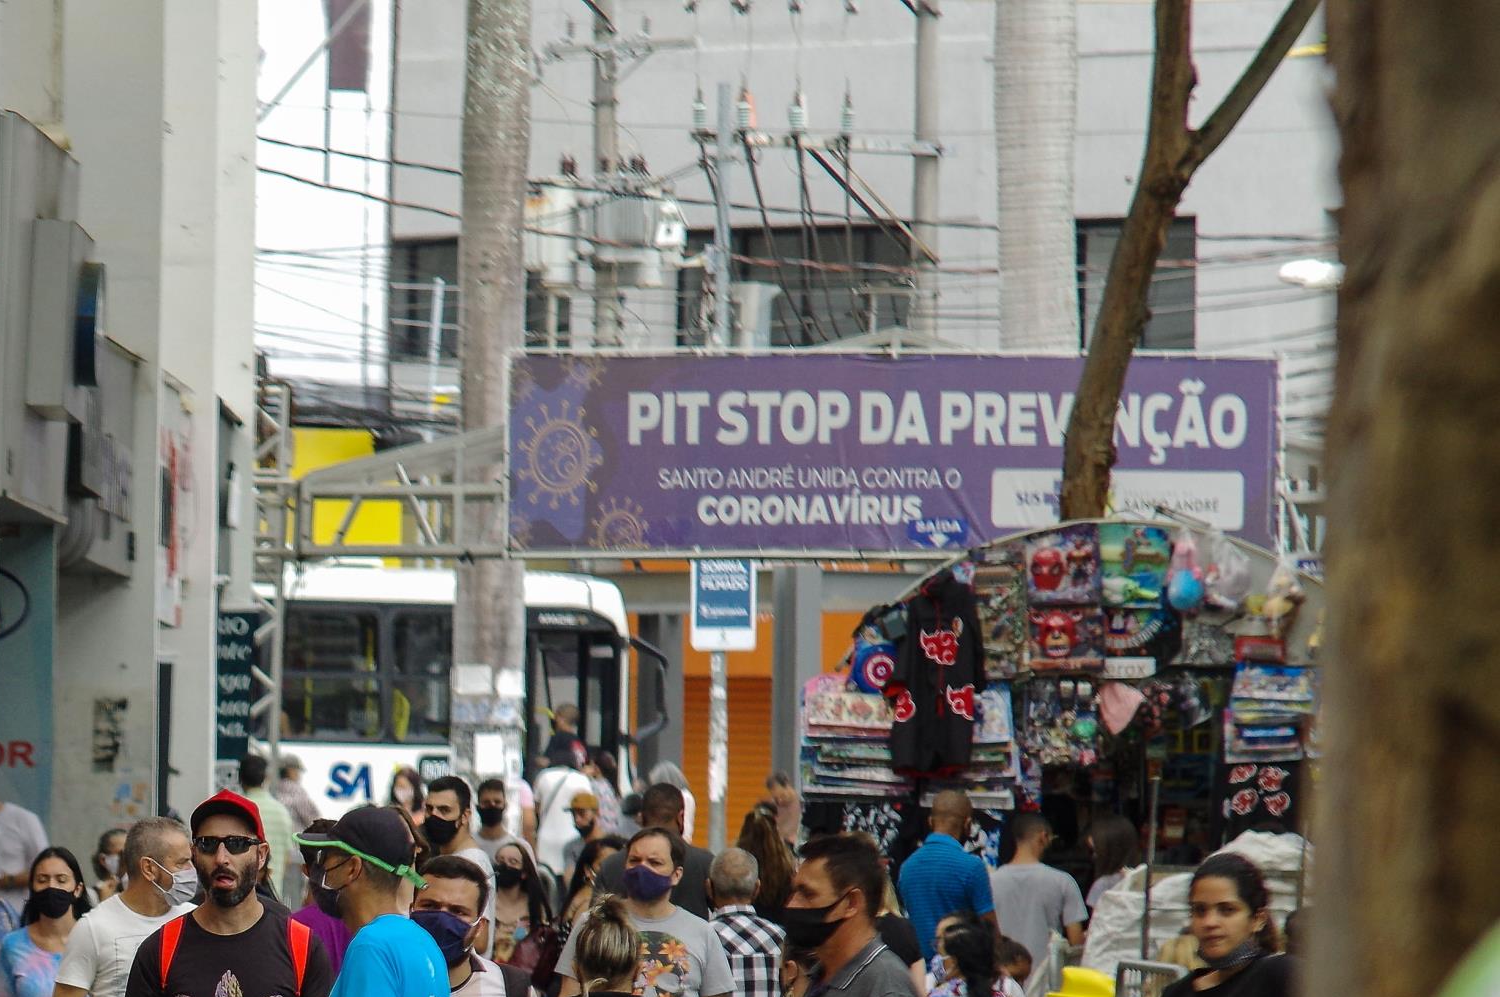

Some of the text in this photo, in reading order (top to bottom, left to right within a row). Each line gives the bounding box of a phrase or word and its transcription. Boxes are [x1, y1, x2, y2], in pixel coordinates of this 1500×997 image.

[627, 379, 1248, 465] PIT STOP DA PREVNÇÃO
[658, 463, 963, 490] SANTO ANDRÉ UNIDA CONTRA O
[697, 486, 923, 527] CORONAVÍRUS
[915, 519, 963, 534] SAÍDA
